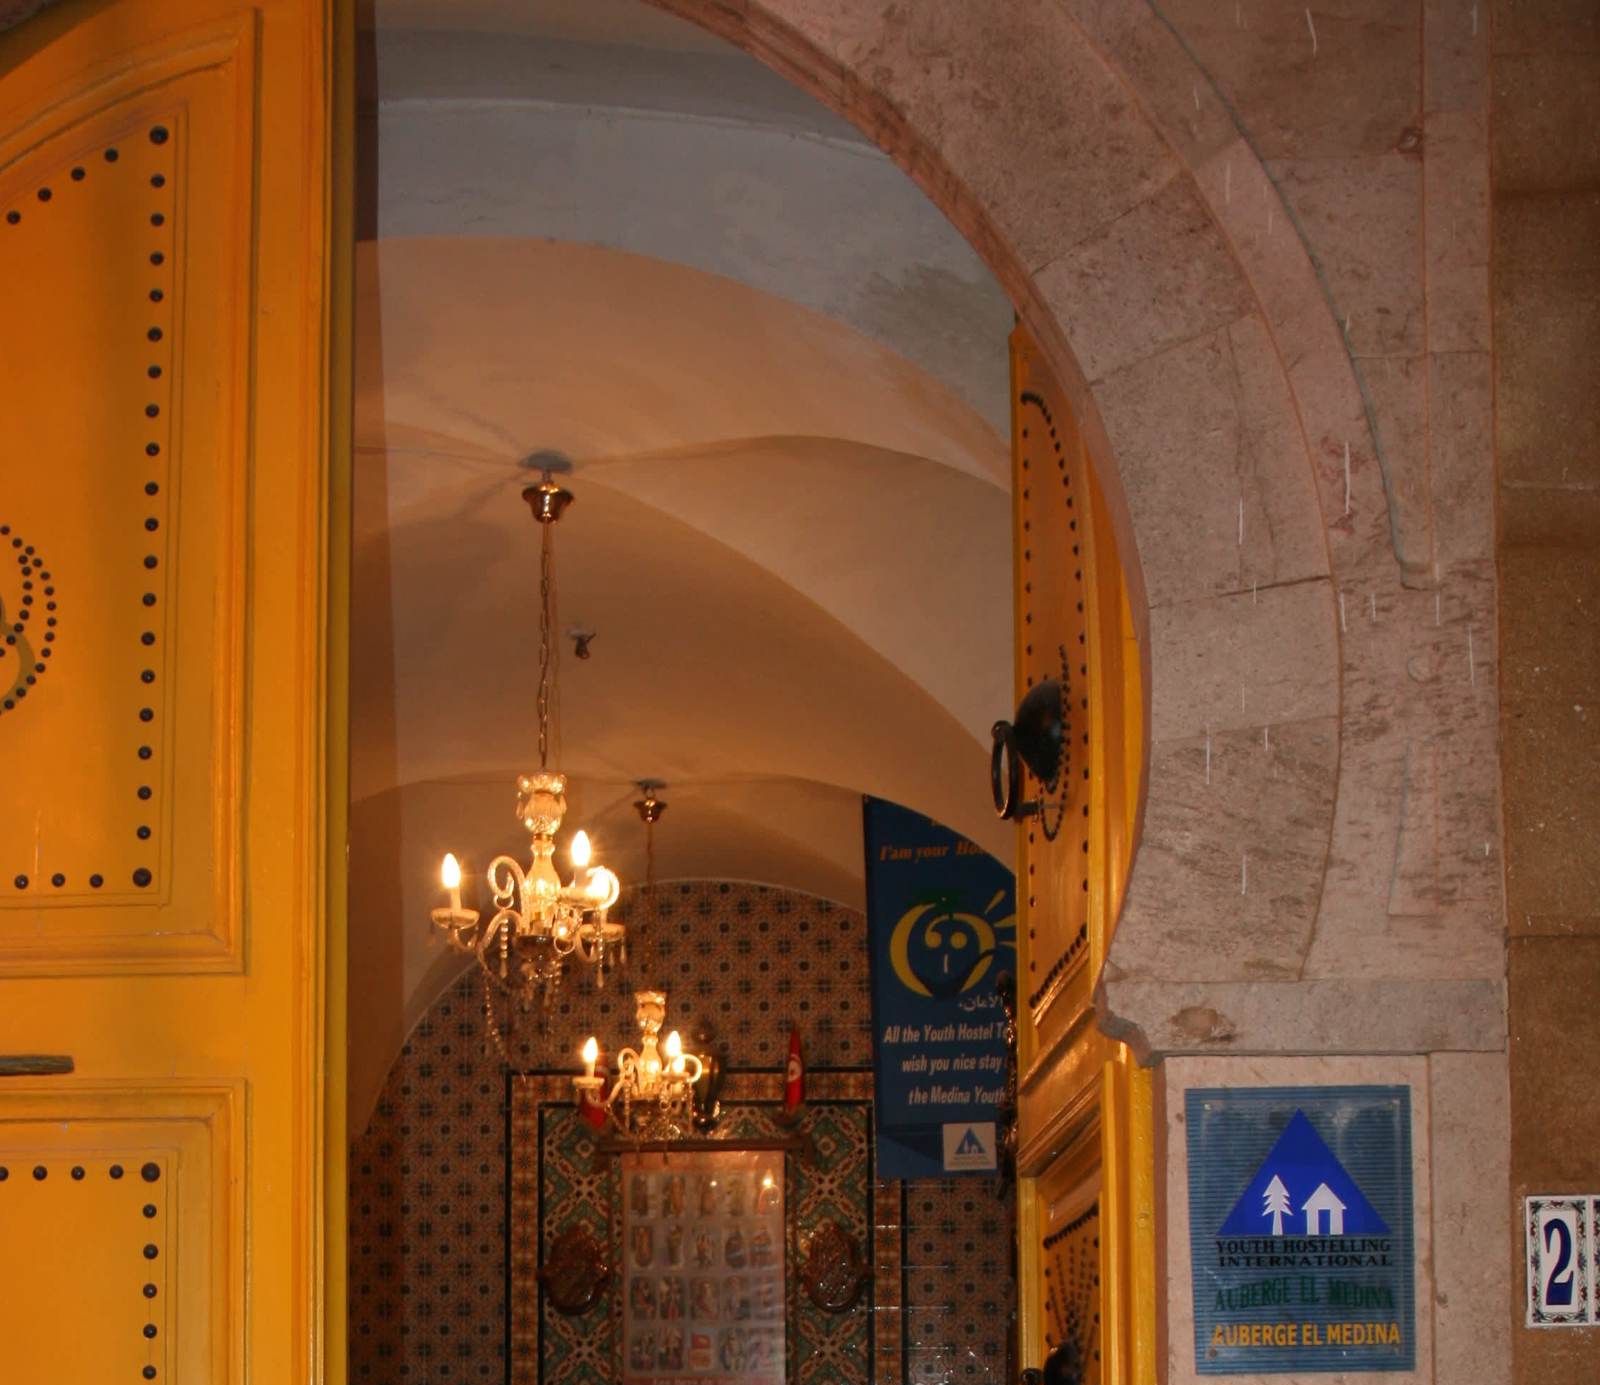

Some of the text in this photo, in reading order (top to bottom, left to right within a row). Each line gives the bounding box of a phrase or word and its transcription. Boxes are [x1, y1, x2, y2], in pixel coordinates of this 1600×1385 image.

[913, 845, 949, 864] your
[883, 1025, 900, 1044] All
[902, 1024, 920, 1042] the
[924, 1023, 955, 1042] Youth
[958, 1021, 994, 1041] Hostel
[902, 1054, 927, 1073] wish
[929, 1058, 950, 1076] you
[953, 1053, 977, 1071] nice
[979, 1054, 1002, 1074] stay
[908, 1084, 1006, 1105] the Medina Youth
[1216, 1238, 1391, 1255] YOUTH HOSTELLING
[1219, 1254, 1392, 1267] INTERNATIONAL
[1543, 1218, 1574, 1305] 2
[1215, 1276, 1394, 1311] AUBERGE EL MEDINA
[1213, 1322, 1400, 1346] AUBERGE EL MEDINA
